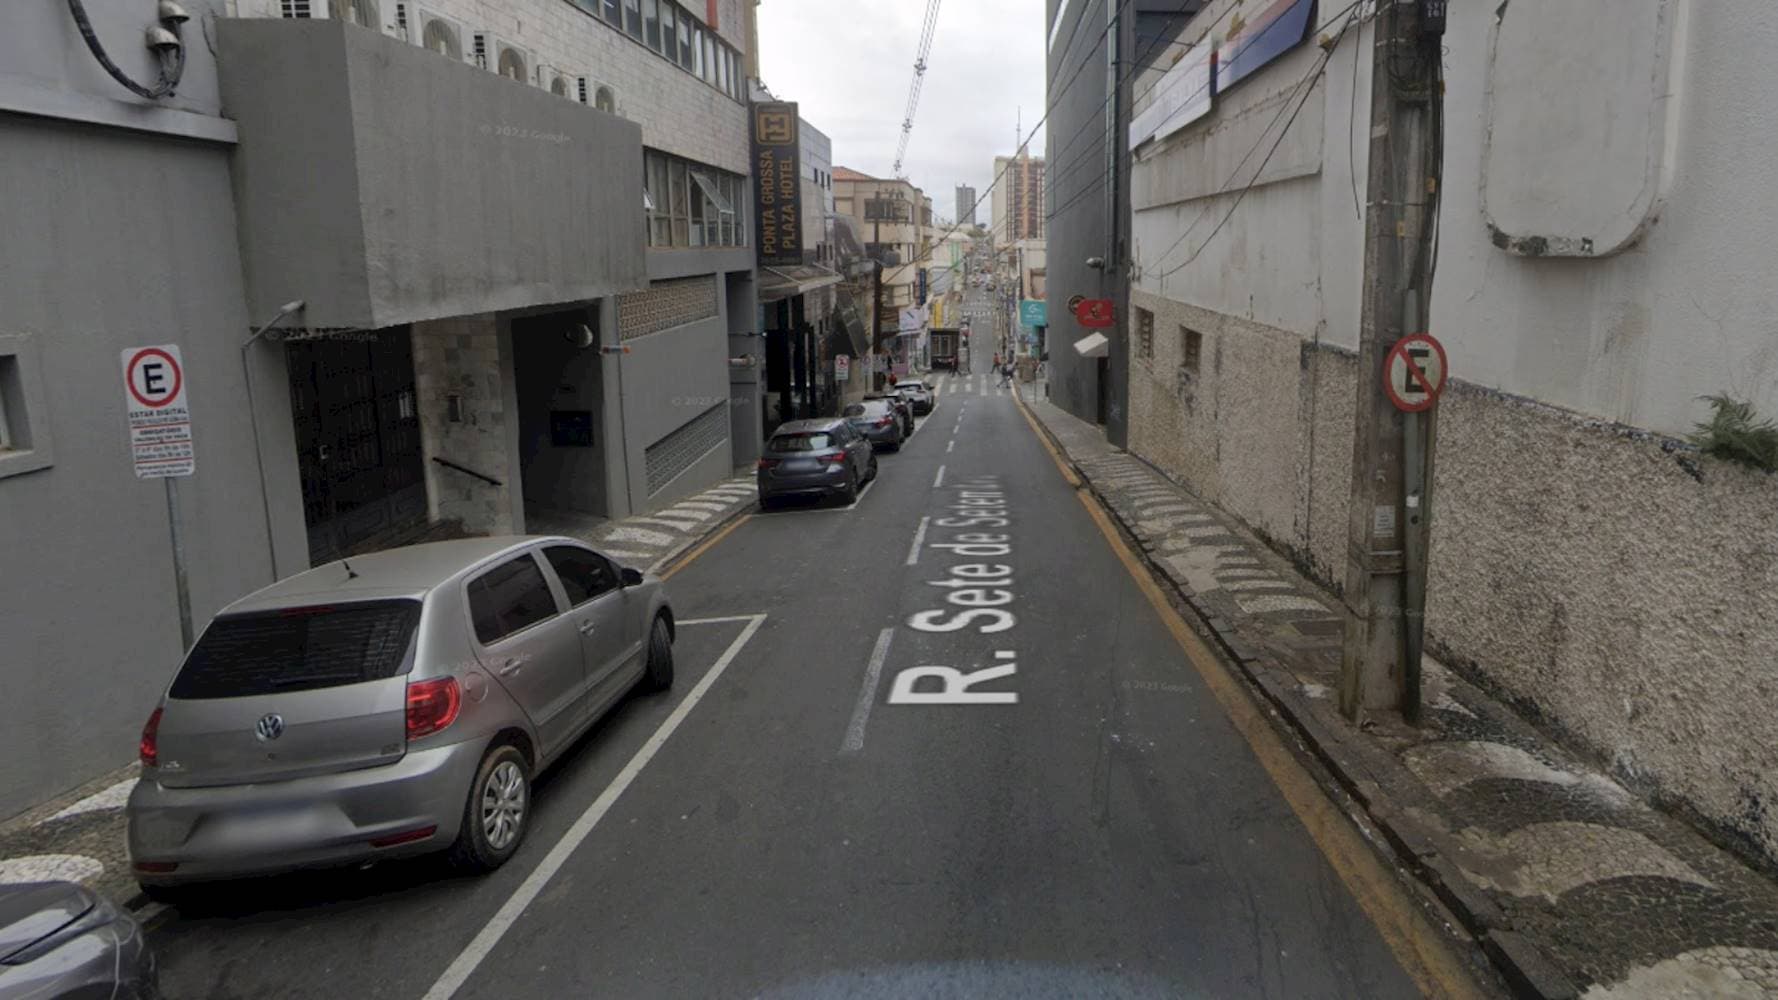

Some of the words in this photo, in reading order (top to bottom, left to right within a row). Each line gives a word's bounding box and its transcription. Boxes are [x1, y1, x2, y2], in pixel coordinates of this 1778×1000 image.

[759, 151, 775, 205] GROSSA
[780, 156, 794, 200] HOTEL
[762, 209, 776, 255] PONTA
[782, 204, 796, 249] PLAZA
[143, 362, 166, 394] E
[1405, 348, 1430, 393] E
[156, 407, 187, 416] DIGITAL
